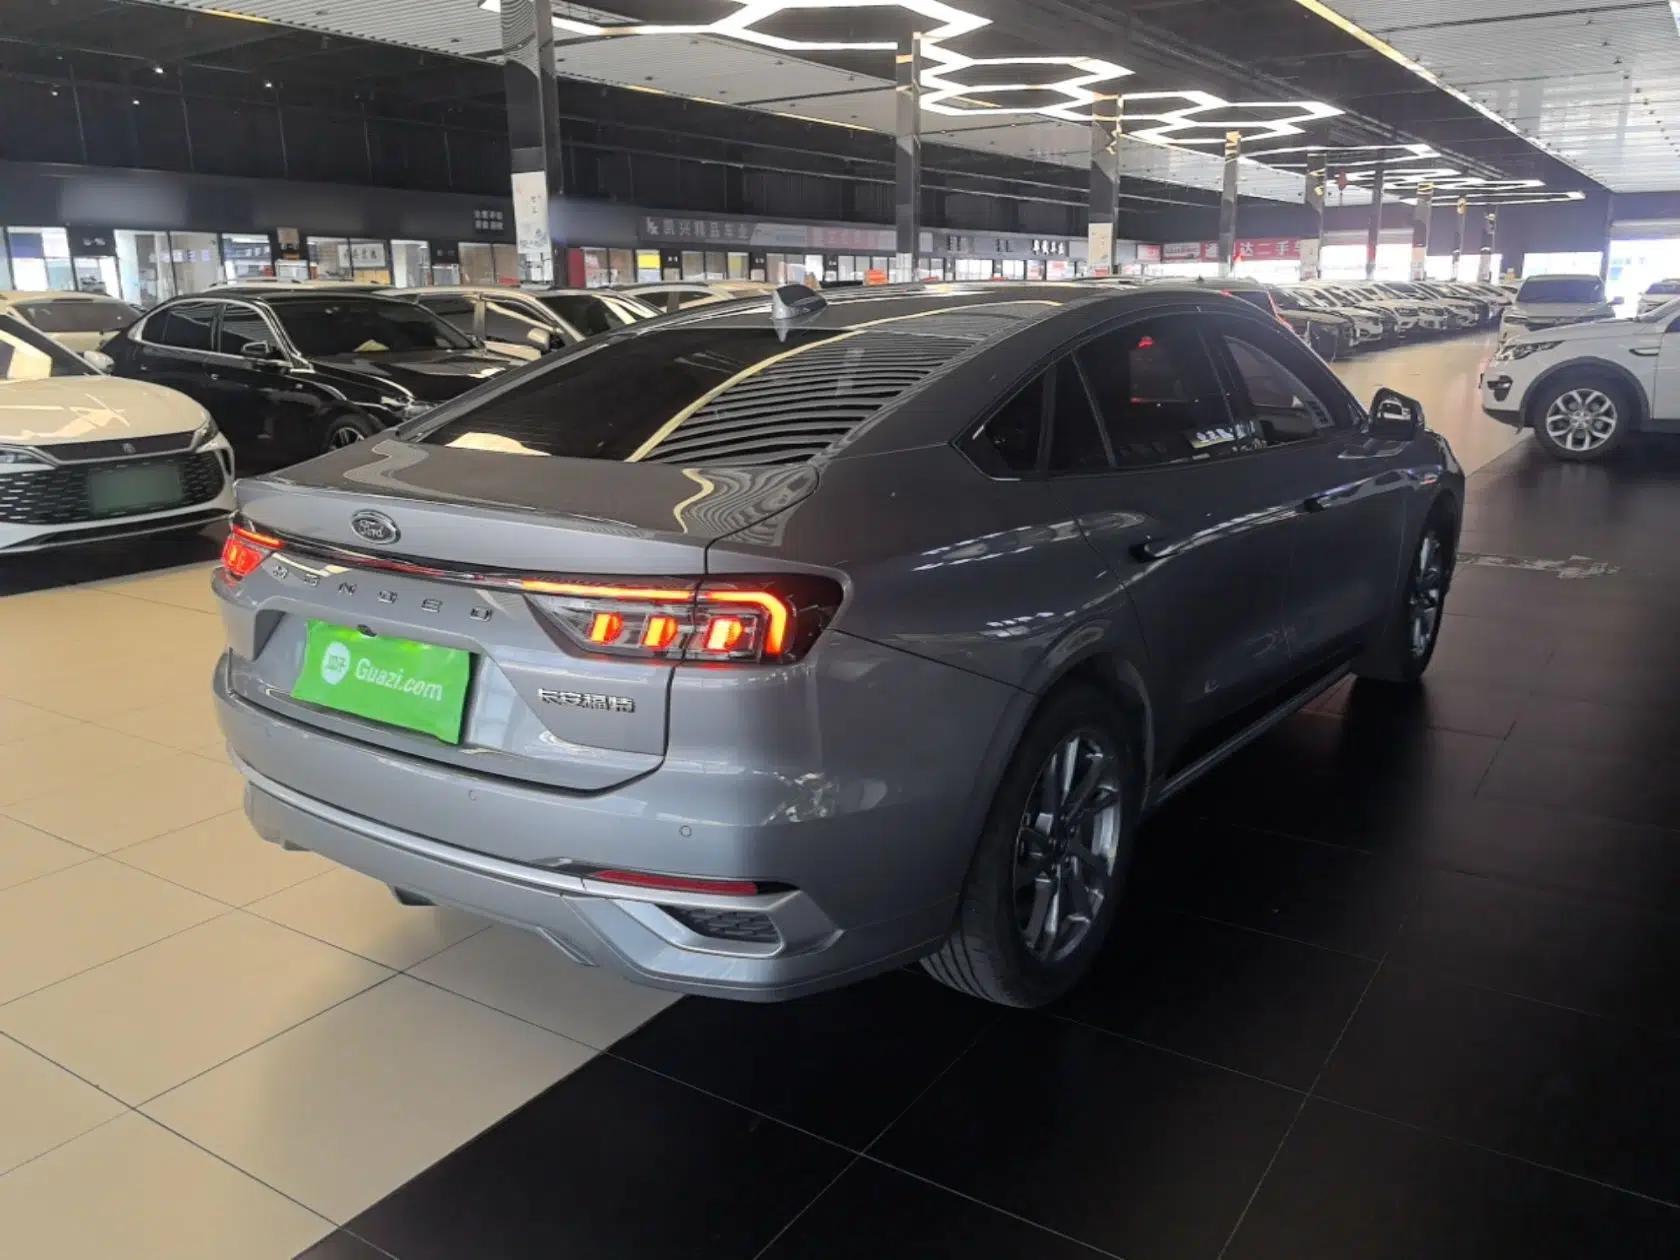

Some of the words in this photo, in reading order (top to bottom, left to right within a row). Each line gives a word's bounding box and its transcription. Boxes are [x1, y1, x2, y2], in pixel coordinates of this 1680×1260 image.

[354, 657, 444, 701] Guazi.com
[538, 688, 635, 713] 长安福特
